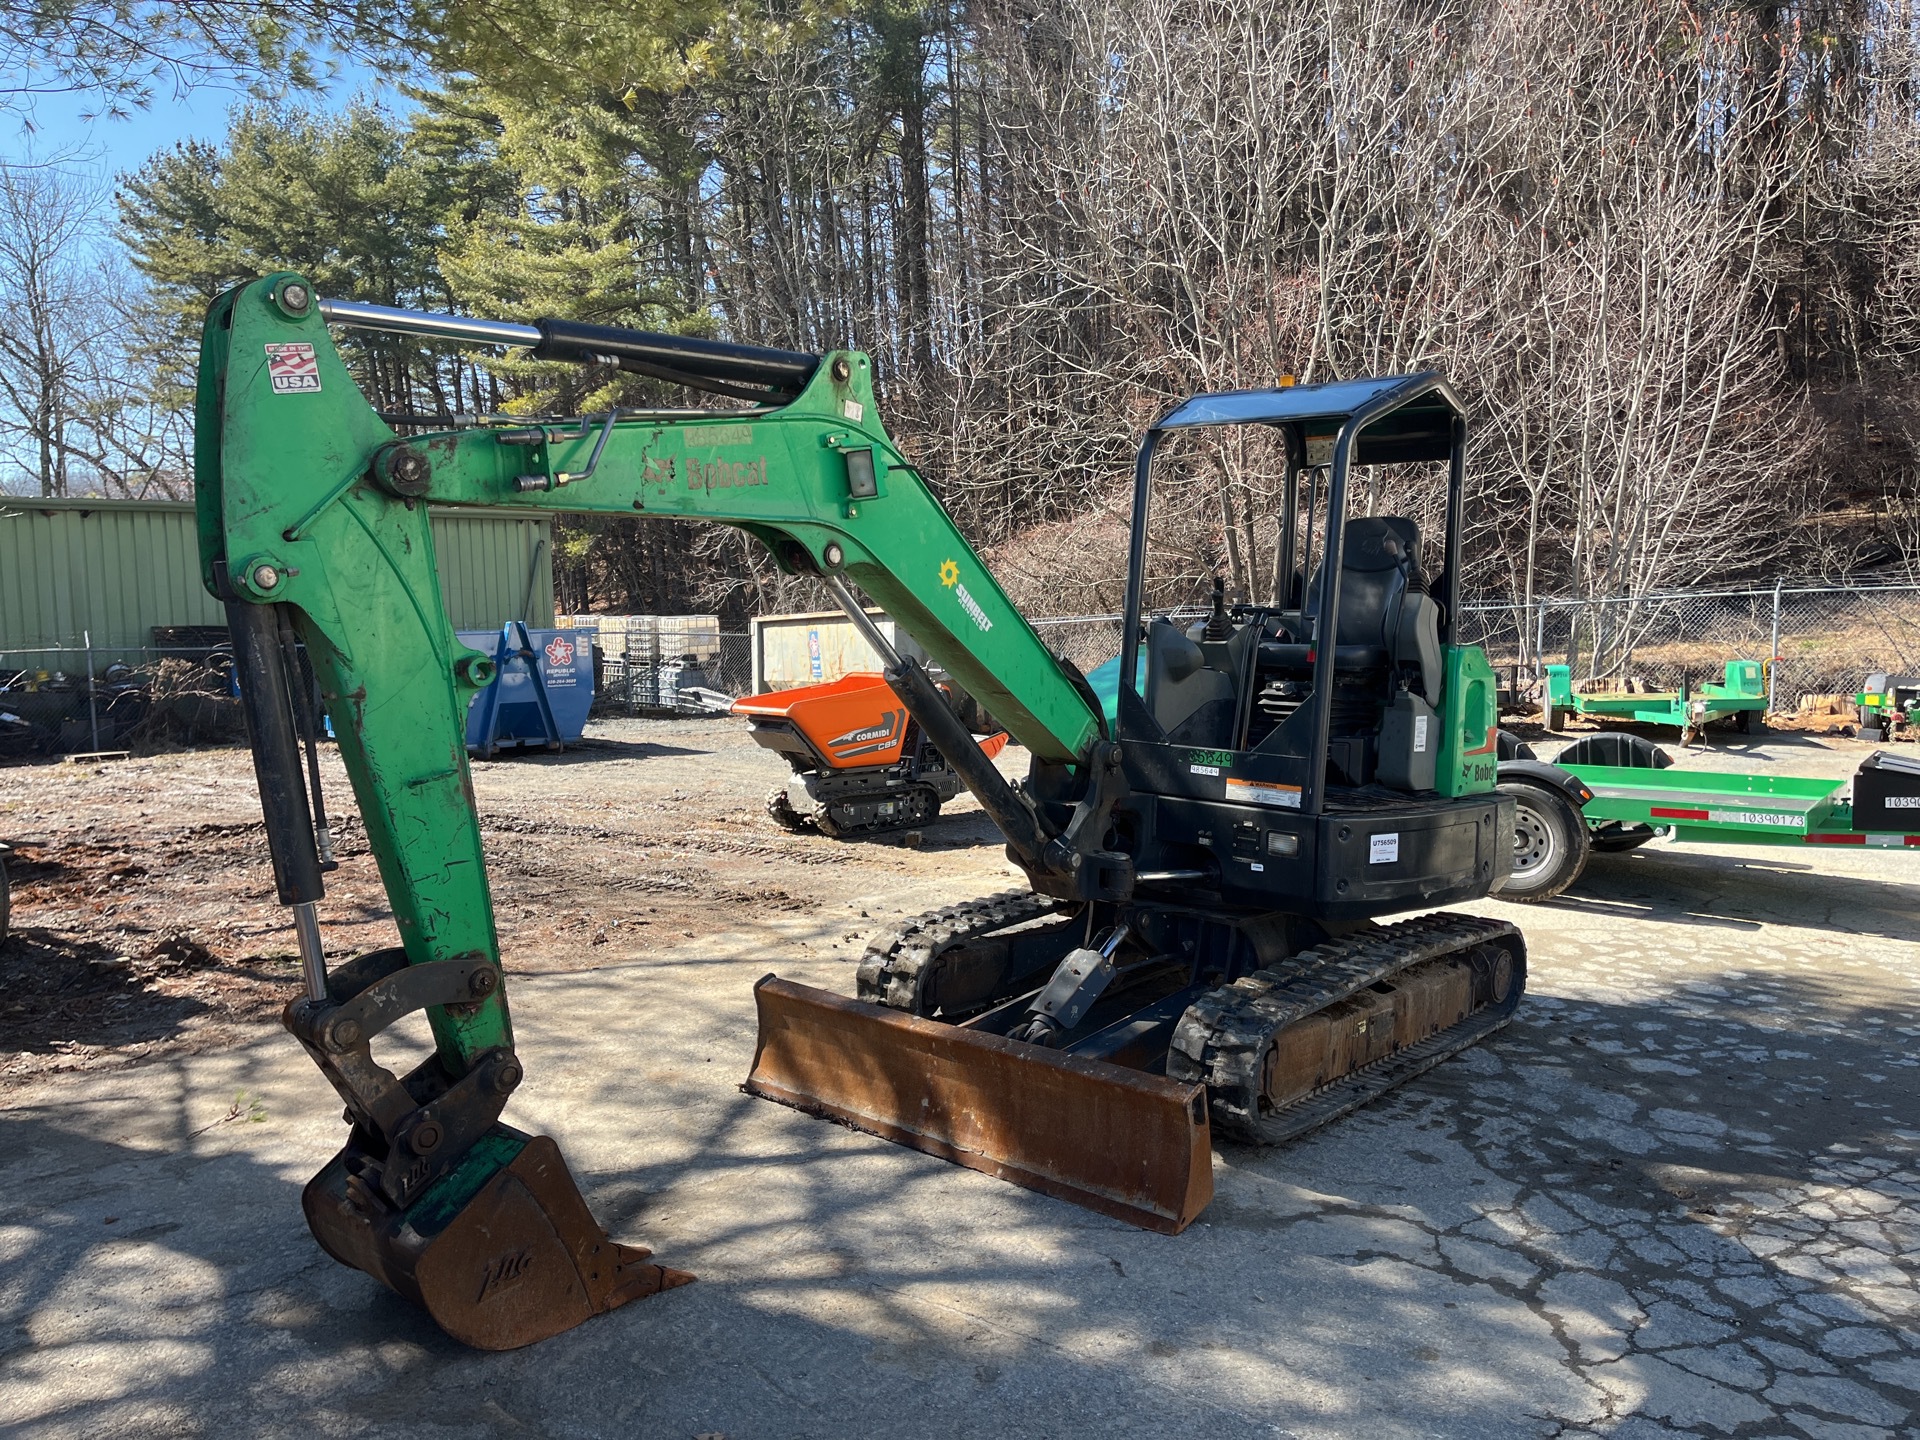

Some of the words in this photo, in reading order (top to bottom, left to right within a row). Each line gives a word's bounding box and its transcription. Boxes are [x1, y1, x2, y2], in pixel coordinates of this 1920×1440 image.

[274, 376, 317, 388] USA
[686, 455, 768, 490] Bobcat
[955, 583, 993, 632] SUNBELT
[957, 597, 983, 631] RENTALS
[856, 729, 890, 741] CORMIDI
[1191, 766, 1218, 775] 985649
[1474, 762, 1493, 781] Bobc
[1741, 813, 1804, 826] 10390173
